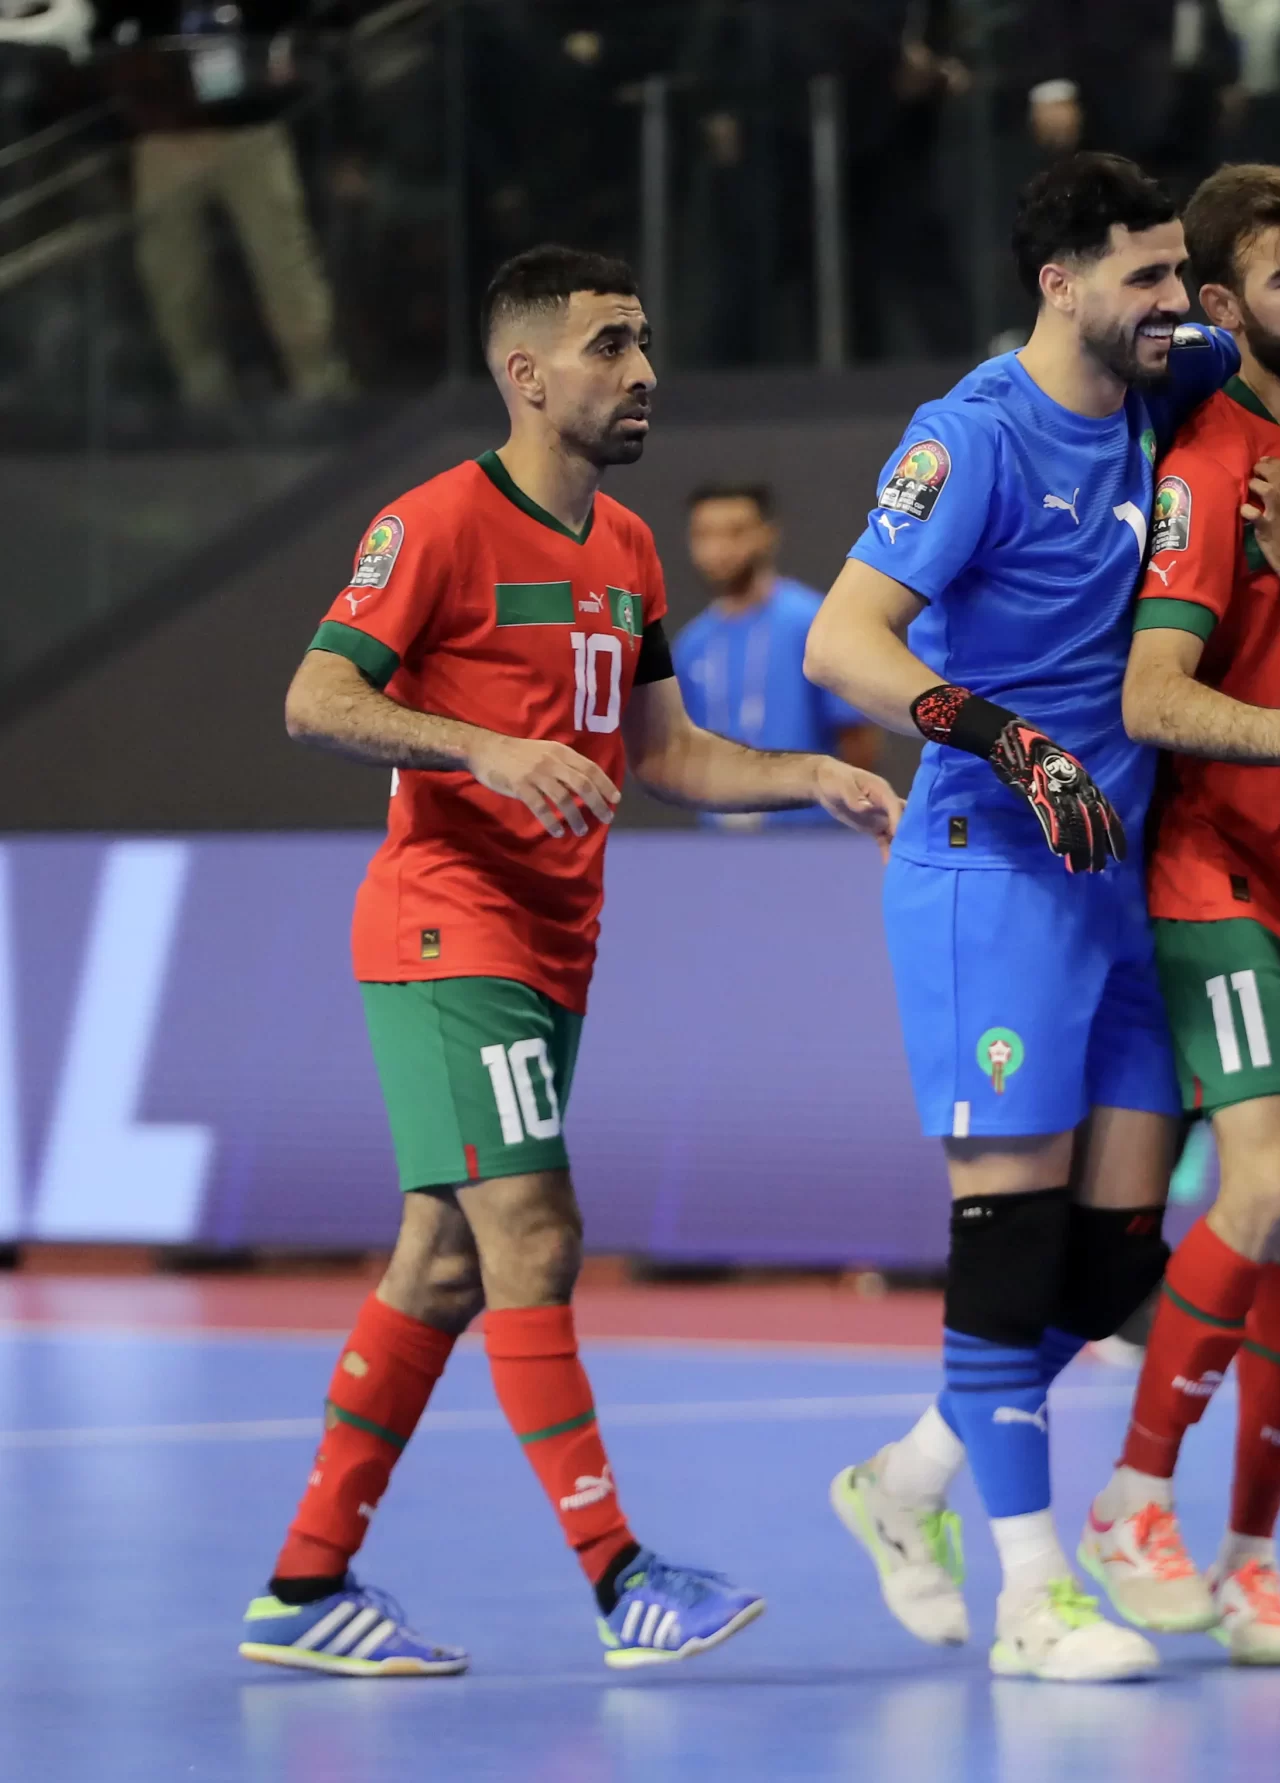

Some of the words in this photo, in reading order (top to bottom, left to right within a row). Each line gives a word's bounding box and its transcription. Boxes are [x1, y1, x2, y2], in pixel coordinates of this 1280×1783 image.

[896, 478, 928, 493] CAF
[570, 631, 622, 734] 10
[0, 840, 215, 1243] L
[1205, 970, 1273, 1075] 11
[480, 1036, 560, 1145] 10
